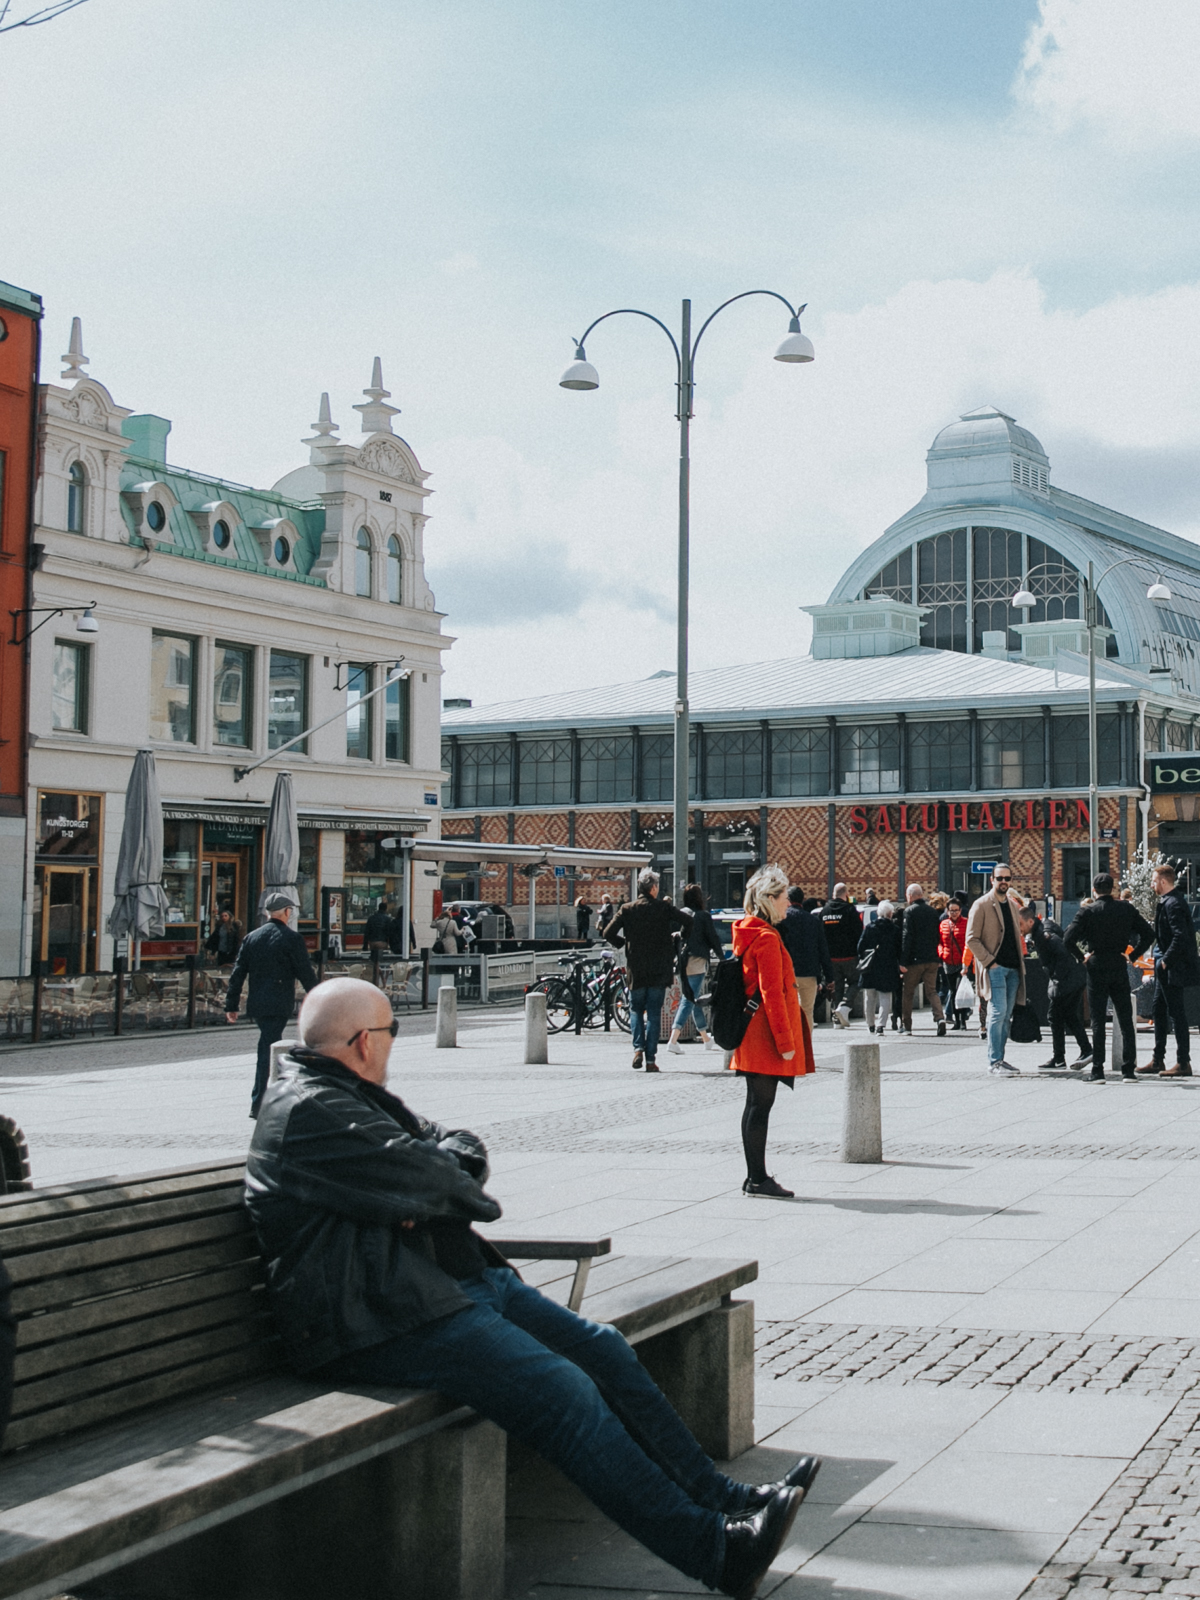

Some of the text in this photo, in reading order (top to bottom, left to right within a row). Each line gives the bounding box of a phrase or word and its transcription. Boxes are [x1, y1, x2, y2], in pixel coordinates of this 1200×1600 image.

[851, 799, 1090, 833] SALUHALLEN
[46, 819, 89, 828] KUNGSTORGET
[61, 830, 74, 838] 11-12
[498, 963, 526, 975] ALDARDO
